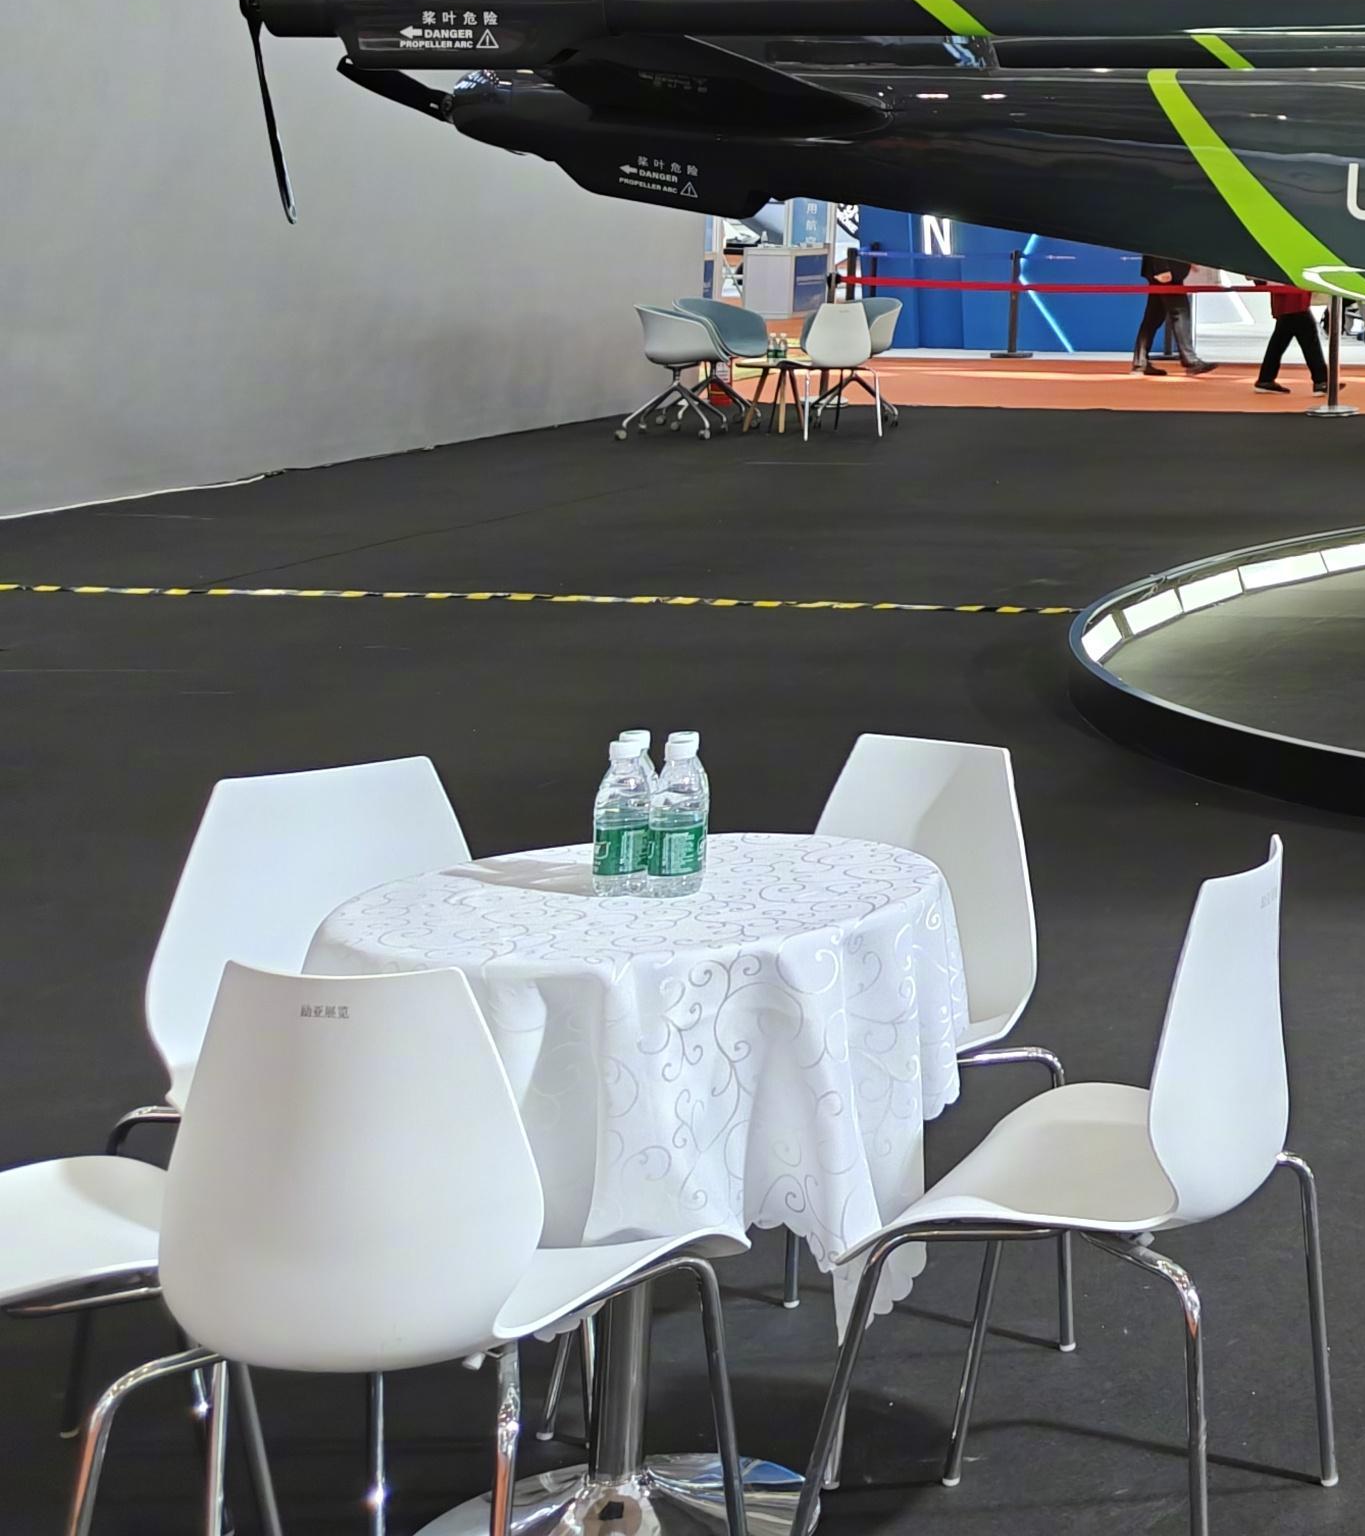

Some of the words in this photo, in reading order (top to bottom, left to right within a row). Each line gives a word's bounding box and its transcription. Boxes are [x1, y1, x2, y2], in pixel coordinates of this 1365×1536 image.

[422, 10, 499, 25] 桨叶危险
[424, 29, 473, 39] DANGER
[400, 40, 453, 48] PROPELLER
[454, 40, 474, 48] ARC
[639, 169, 678, 183] DANGER
[619, 177, 661, 191] PROPELLER
[662, 186, 678, 194] ARC
[922, 215, 952, 255] N
